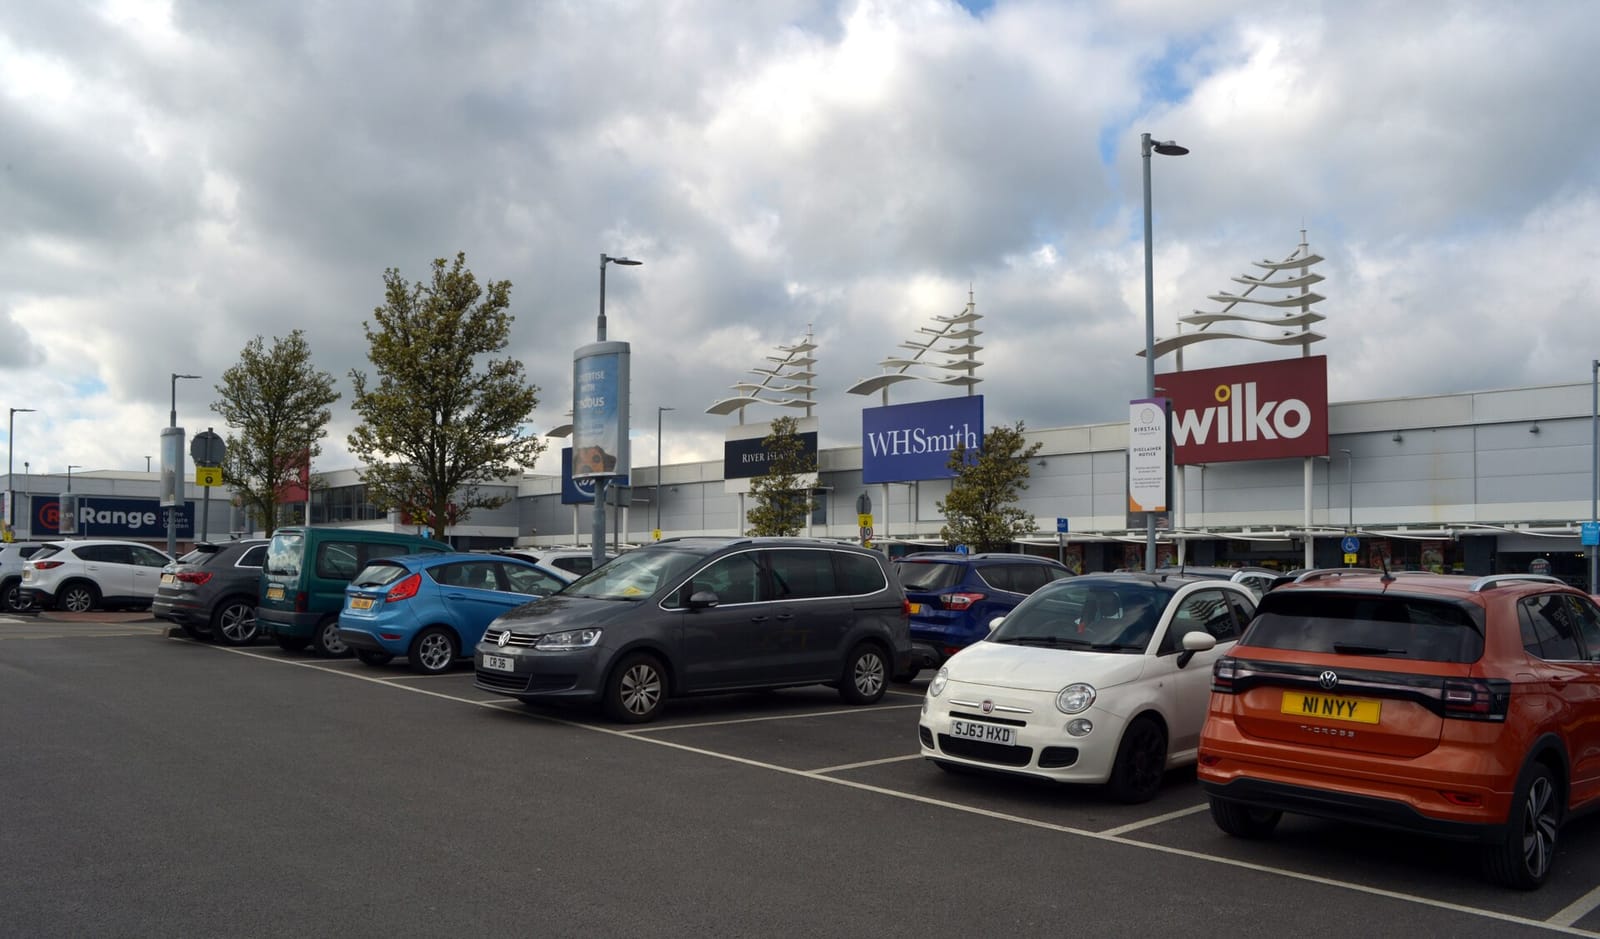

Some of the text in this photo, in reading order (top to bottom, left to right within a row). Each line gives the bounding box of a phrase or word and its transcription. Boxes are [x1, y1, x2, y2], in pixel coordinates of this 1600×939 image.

[1172, 382, 1311, 446] wilko
[867, 423, 978, 457] WHSmith
[742, 453, 765, 463] RIVER
[80, 507, 157, 529] Range
[1322, 699, 1358, 718] NYY
[955, 722, 1010, 742] SJ63 HXD
